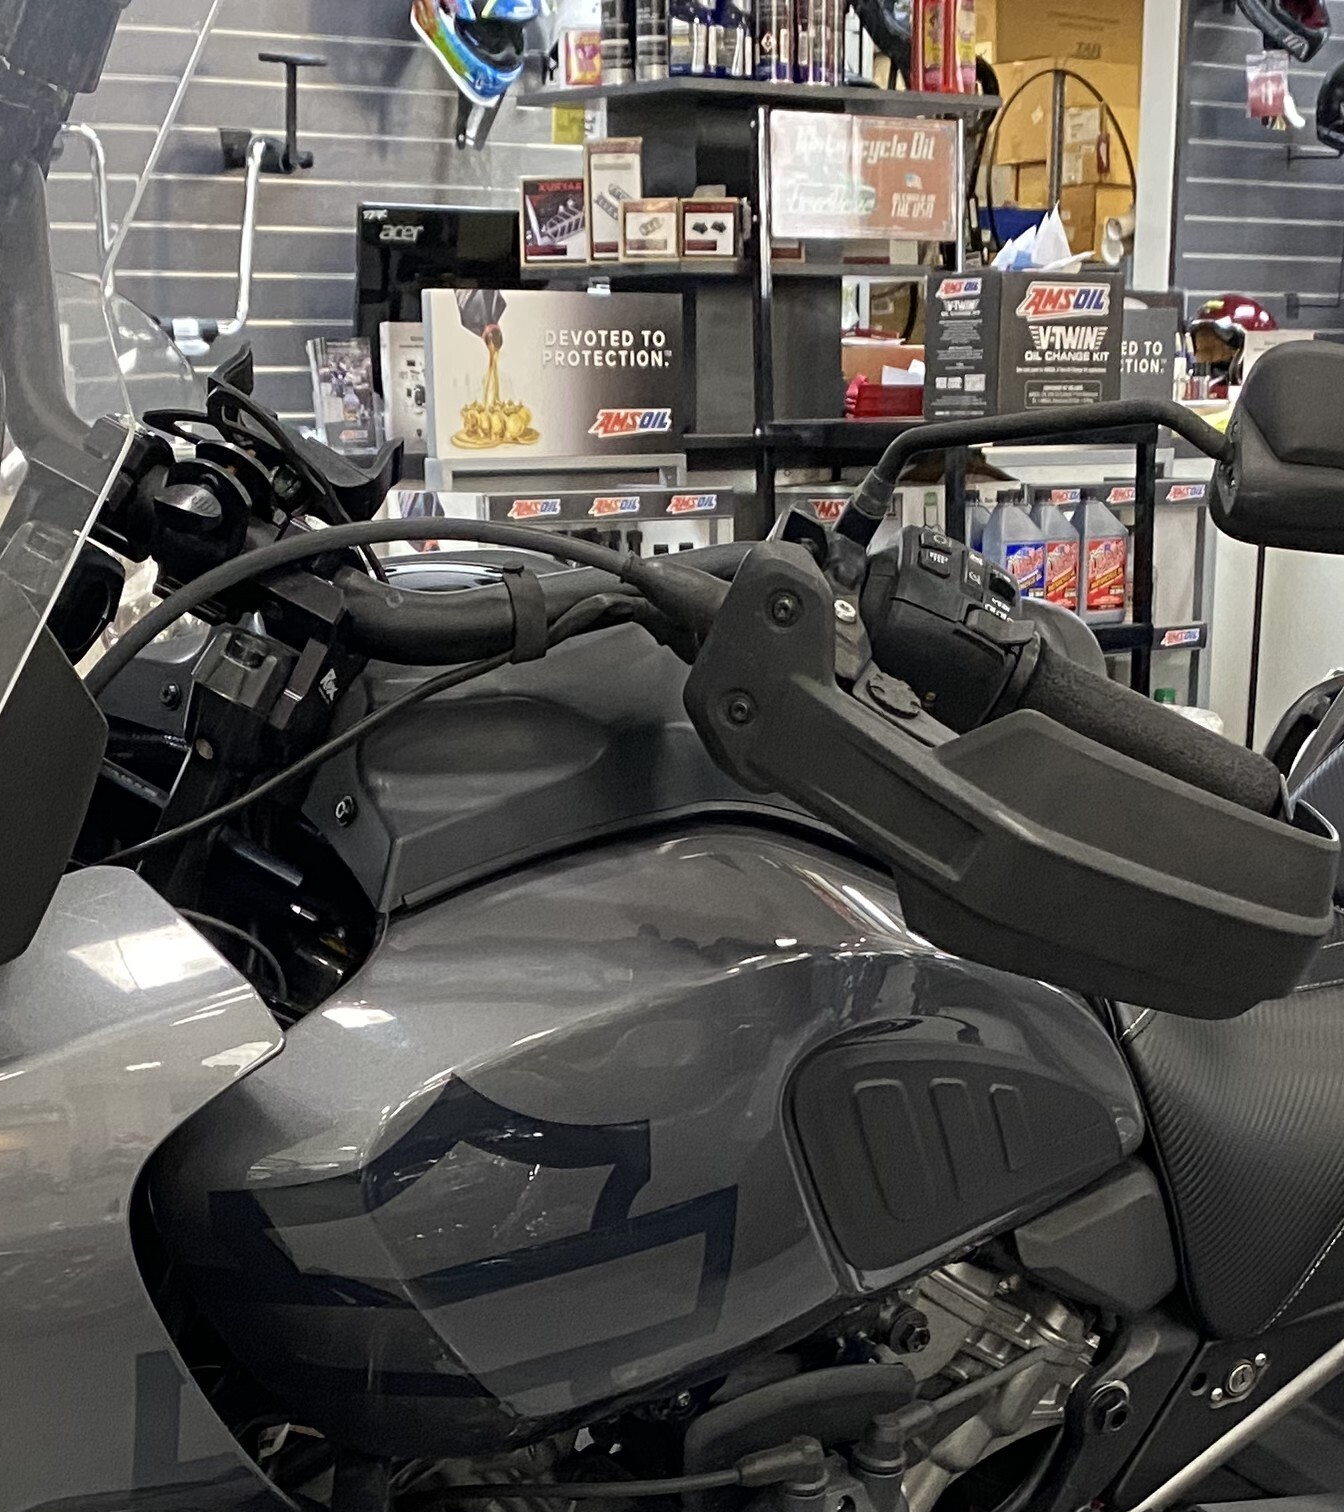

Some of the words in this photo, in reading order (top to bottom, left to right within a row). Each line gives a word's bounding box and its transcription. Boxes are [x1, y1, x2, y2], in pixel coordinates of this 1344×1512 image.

[910, 131, 936, 160] Oil
[378, 223, 424, 243] acer
[1021, 286, 1109, 317] AMSOIL
[543, 329, 638, 347] DEVOTED
[640, 330, 666, 347] TO
[1024, 351, 1042, 361] OIL
[1044, 351, 1089, 362] CHANGE
[1092, 351, 1110, 361] KIT
[590, 409, 671, 436] AMSOIL
[508, 498, 561, 518] AMSOIL
[588, 496, 640, 516] AMSOIL
[666, 494, 717, 515] AMSOIL
[1161, 628, 1200, 647] AMSOIL
